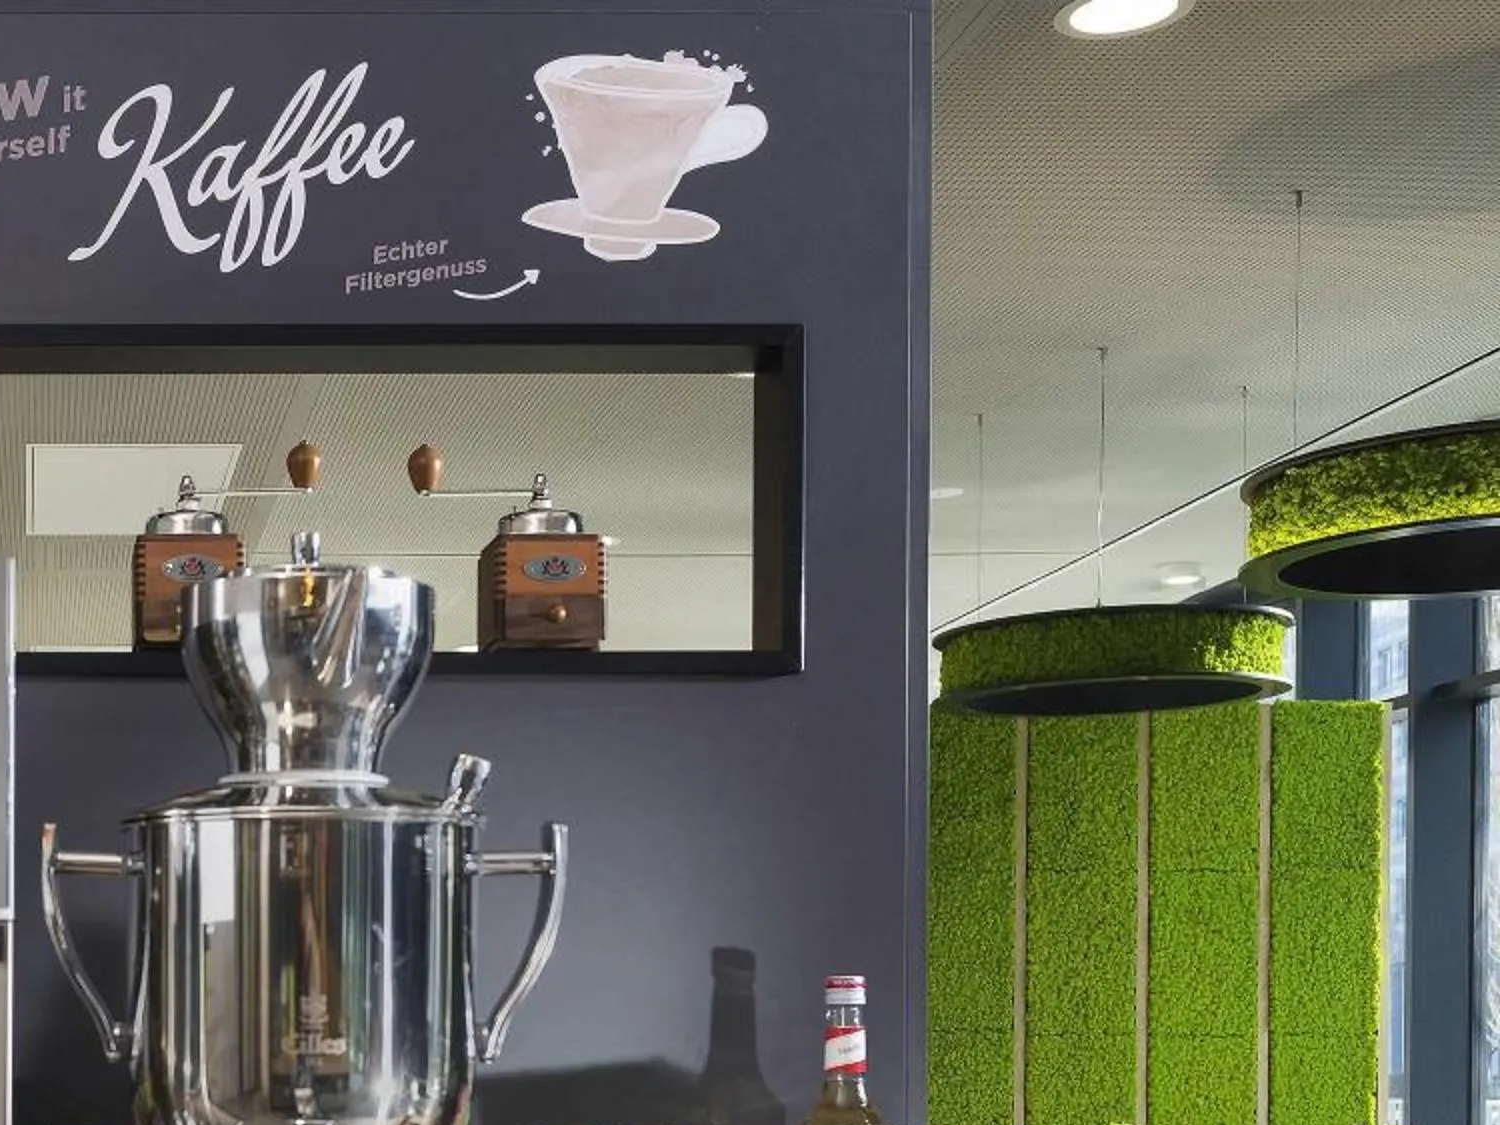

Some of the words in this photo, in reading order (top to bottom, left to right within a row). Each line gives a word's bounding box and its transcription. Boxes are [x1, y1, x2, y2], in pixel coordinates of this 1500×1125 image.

[63, 85, 87, 113] it
[68, 61, 416, 273] Kaffee
[373, 237, 450, 266] Echter
[345, 257, 488, 296] Filtergenuss
